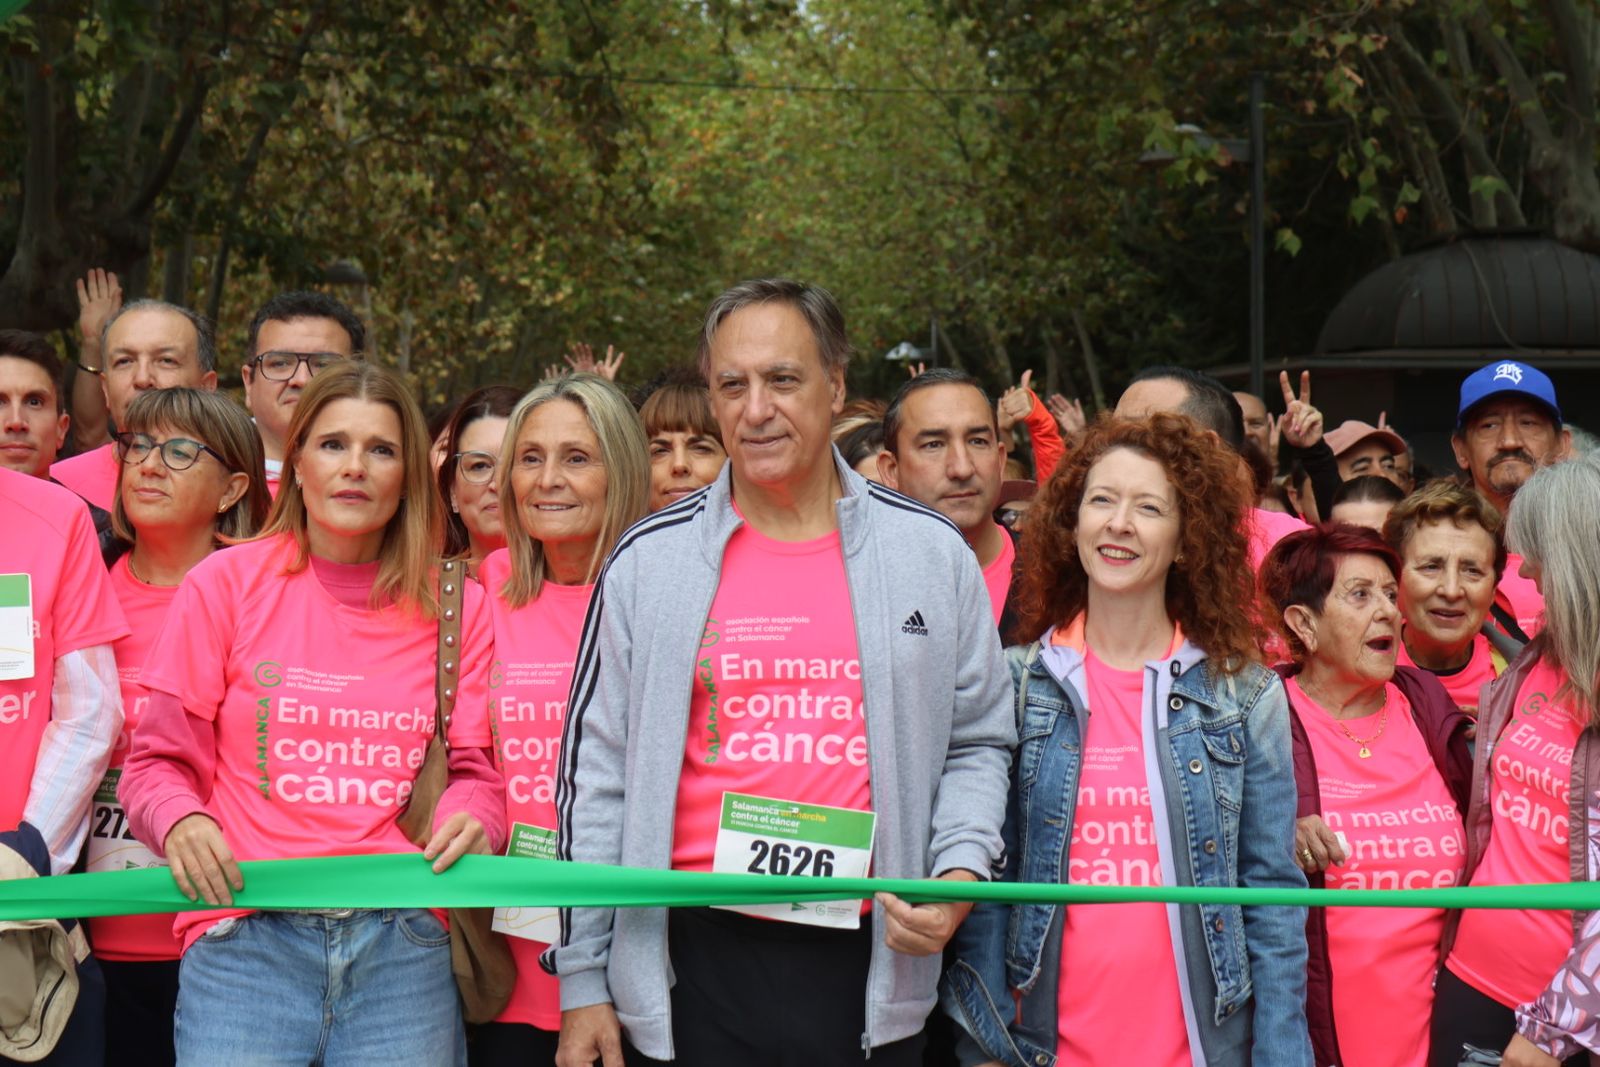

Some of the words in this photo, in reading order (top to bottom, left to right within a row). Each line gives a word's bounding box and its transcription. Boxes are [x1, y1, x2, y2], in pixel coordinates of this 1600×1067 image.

[726, 626, 752, 634] contra
[901, 625, 928, 637] adidas
[720, 653, 764, 680] En
[277, 697, 318, 725] En
[501, 696, 536, 722] En
[699, 656, 720, 764] SALAMANCA
[723, 688, 853, 720] contra
[1510, 723, 1542, 752] En
[274, 737, 401, 768] contra
[407, 739, 427, 769] el
[275, 766, 415, 807] cánce
[731, 811, 758, 822] contra
[760, 814, 769, 823] el
[769, 815, 800, 828] cáncer
[732, 800, 779, 815] Salamanca
[1350, 800, 1456, 828] marcha
[1440, 828, 1465, 856] el
[748, 840, 835, 878] 2626
[1069, 848, 1163, 886] cán
[1325, 863, 1464, 890] ánce
